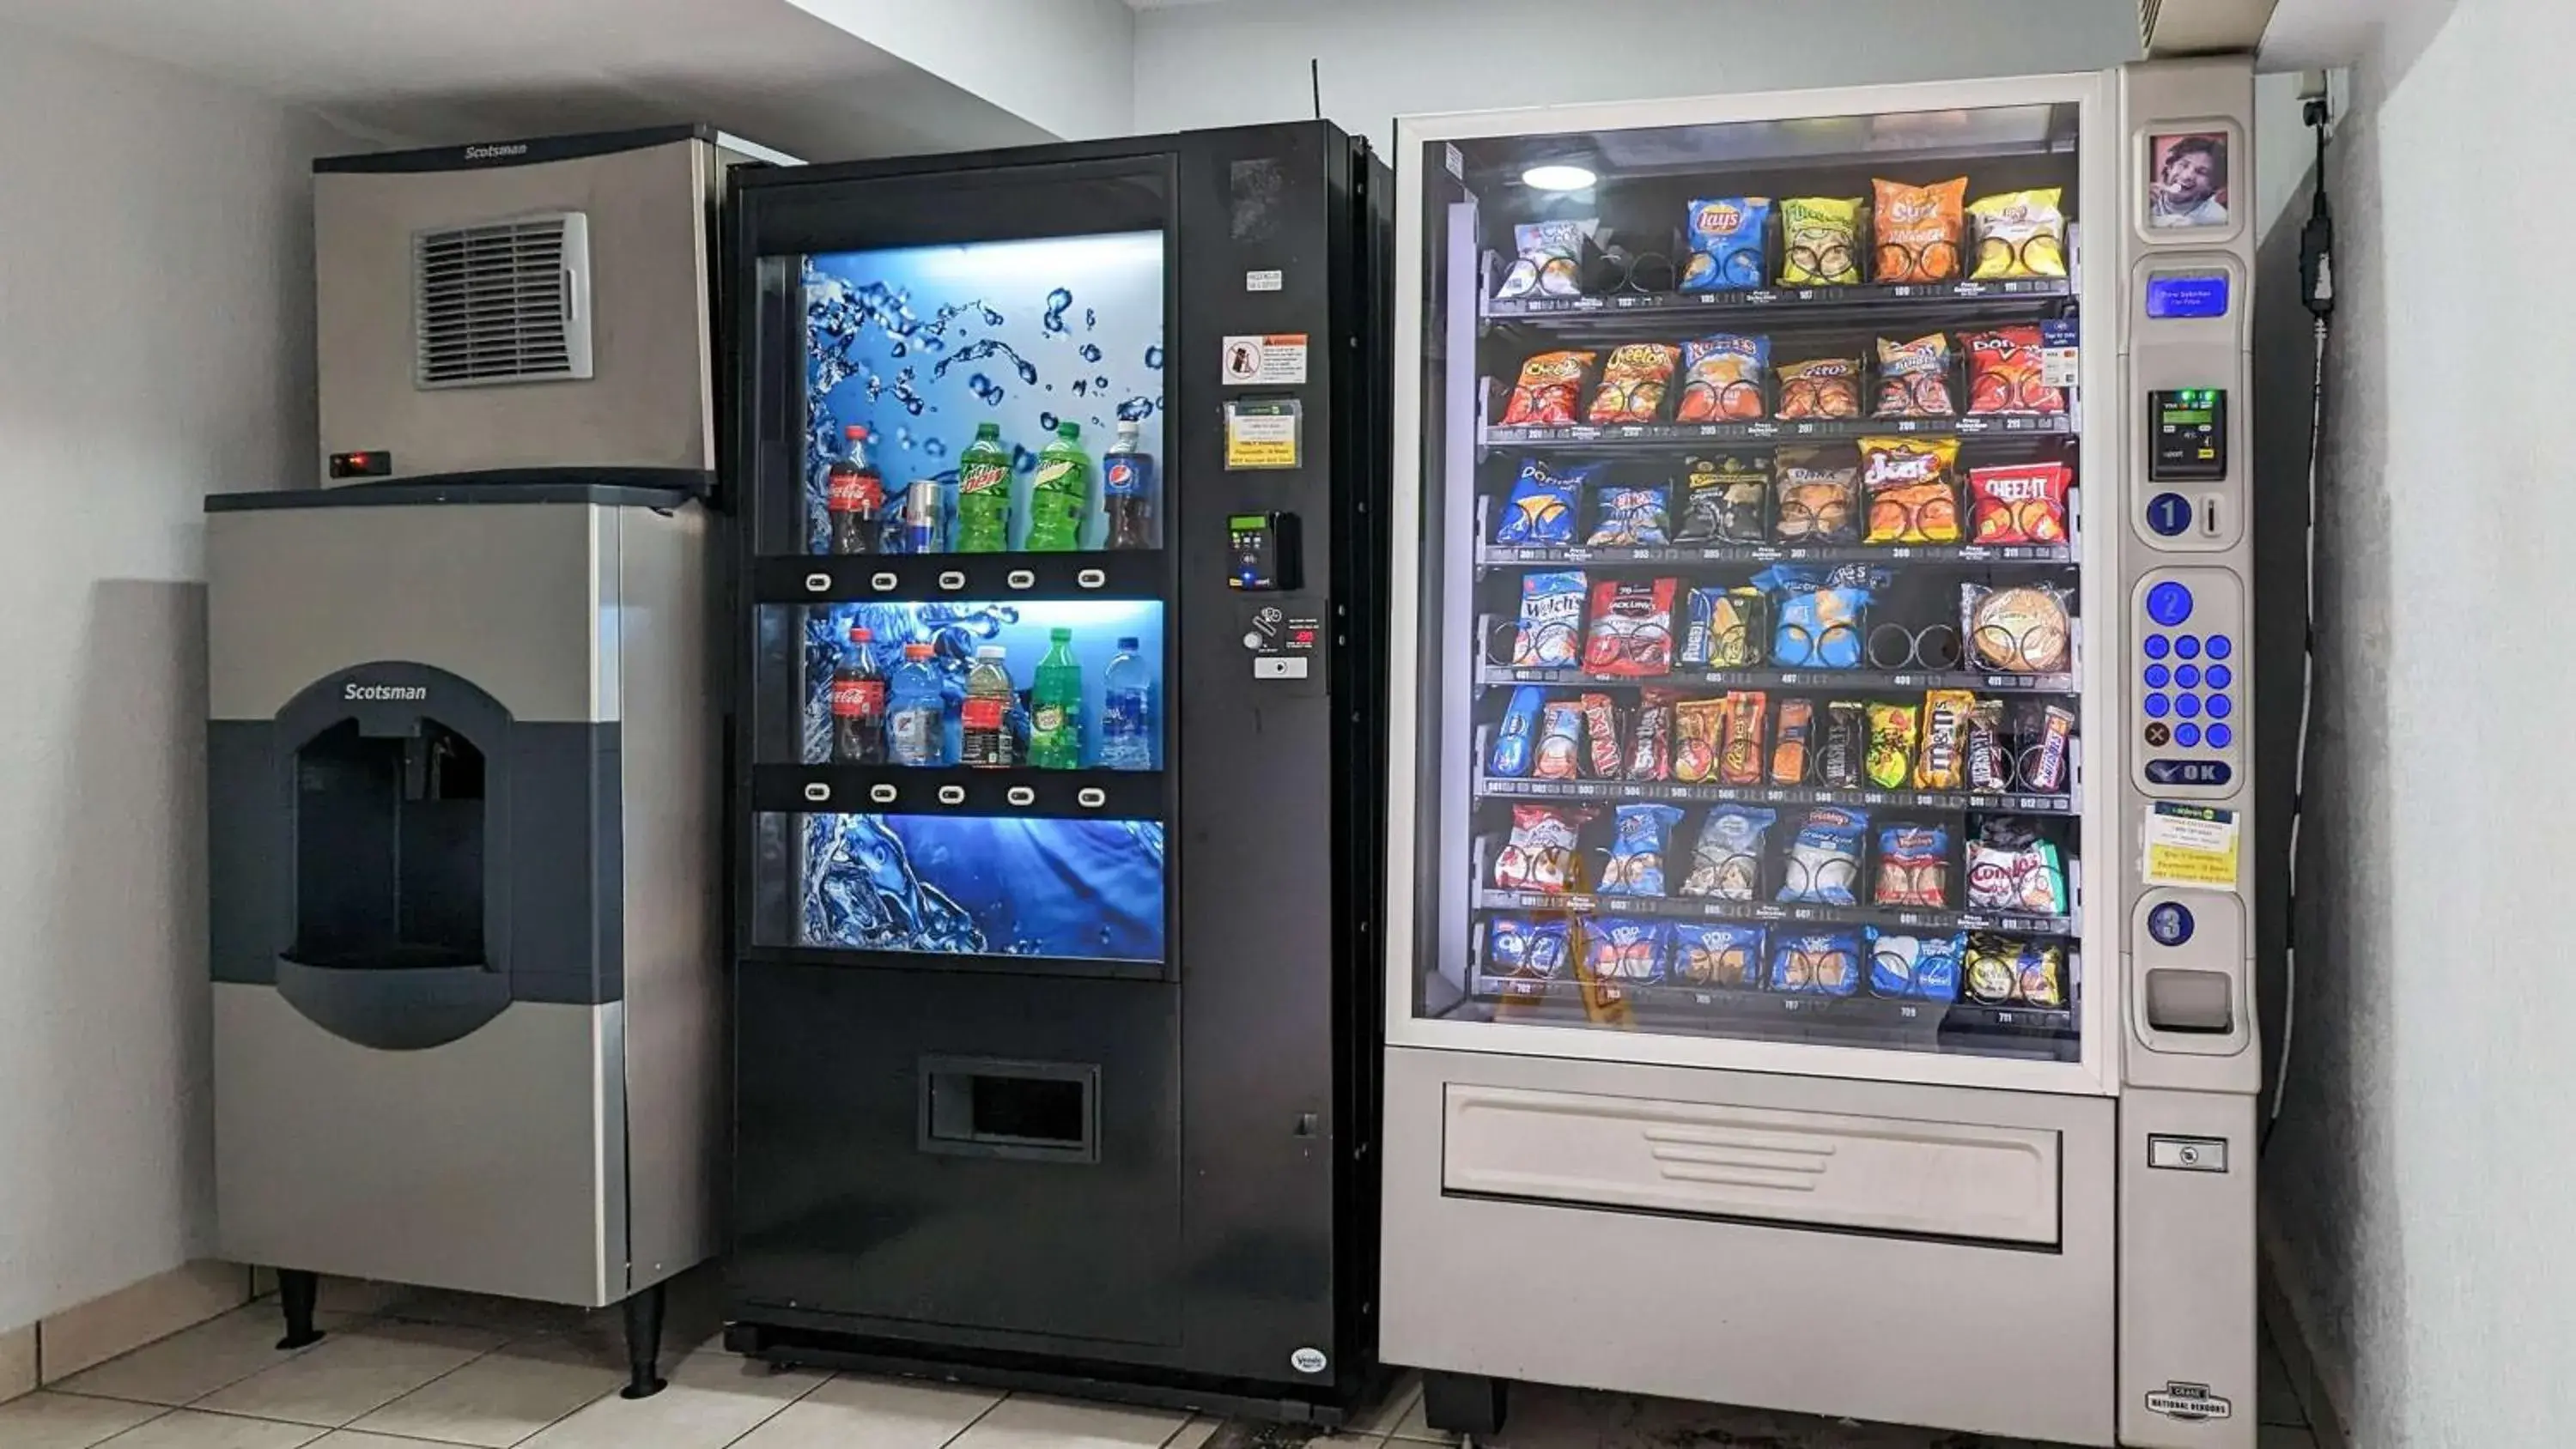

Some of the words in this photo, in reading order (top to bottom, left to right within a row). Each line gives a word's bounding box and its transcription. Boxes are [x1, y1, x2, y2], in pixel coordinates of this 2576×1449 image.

[2161, 500, 2175, 528] 1
[2164, 591, 2179, 617] 2
[344, 683, 427, 700] Scotsman
[2184, 765, 2216, 781] OK
[2161, 908, 2182, 939] 3
